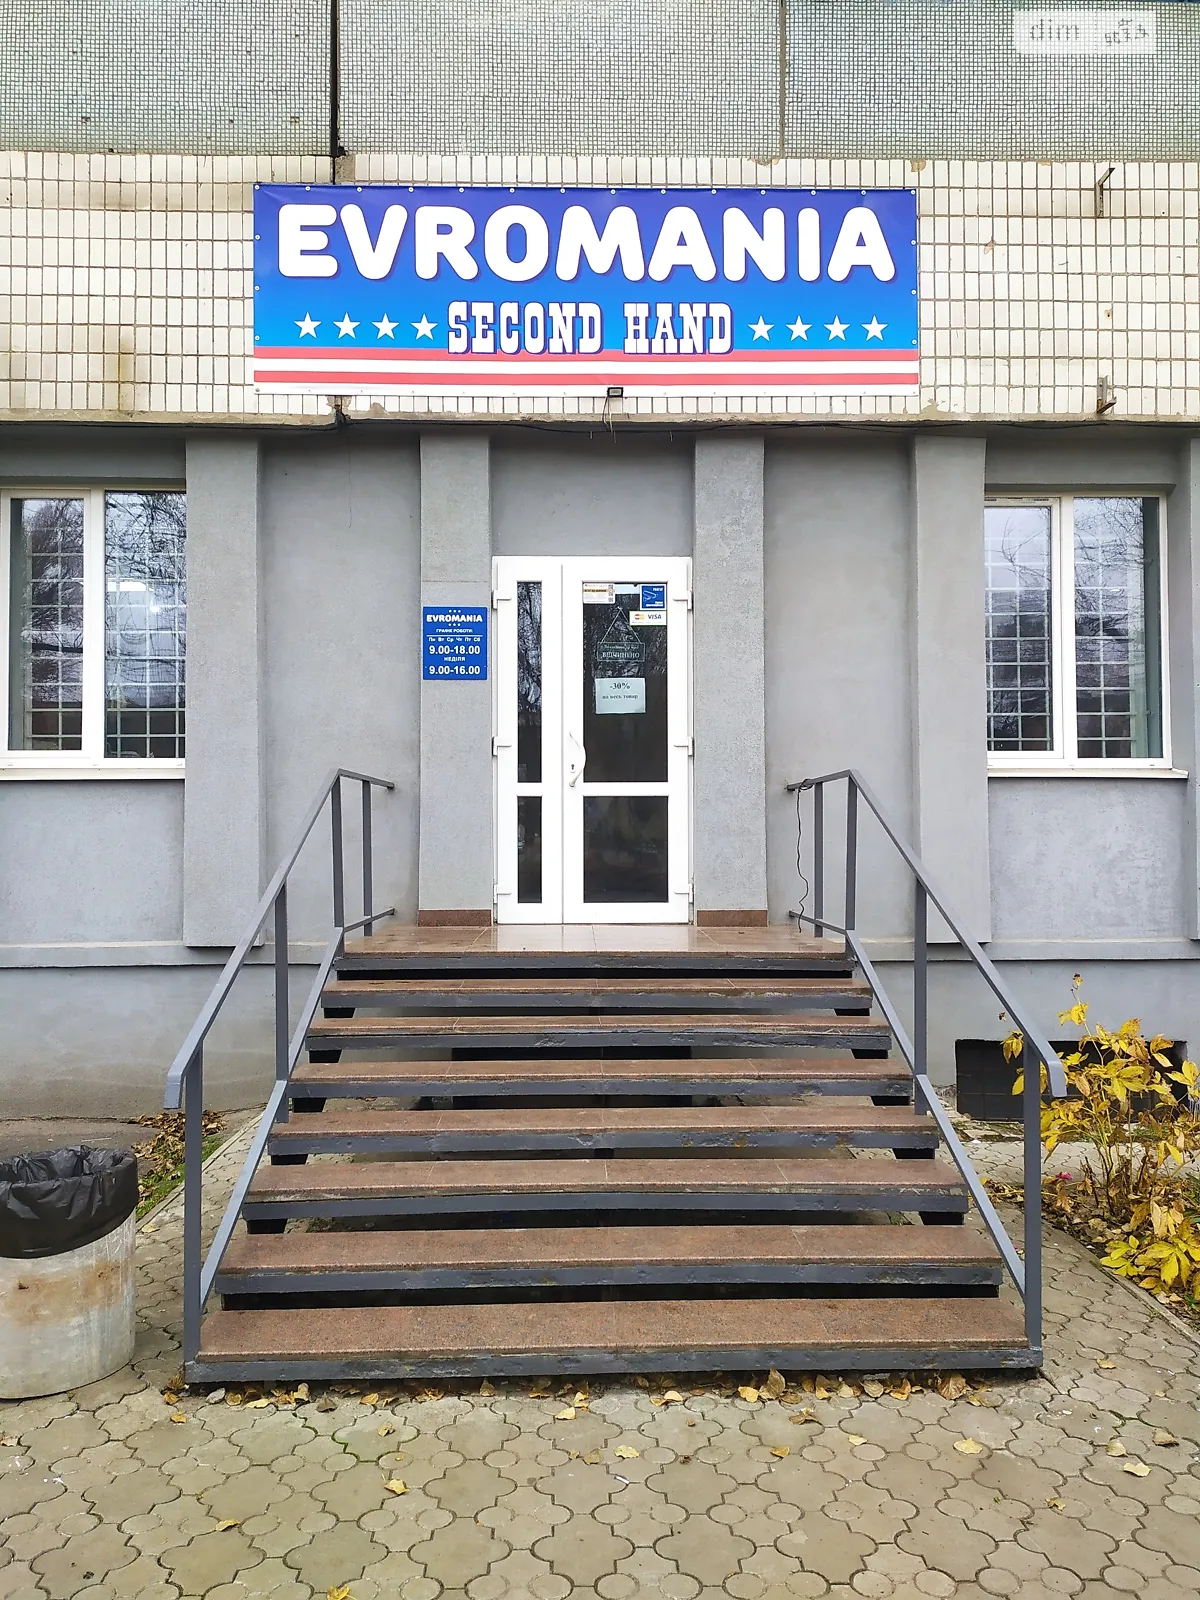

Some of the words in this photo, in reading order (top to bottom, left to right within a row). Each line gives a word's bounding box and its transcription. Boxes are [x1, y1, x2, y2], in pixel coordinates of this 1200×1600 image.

[276, 203, 897, 283] EVROMANIA
[446, 301, 604, 355] SECOND
[623, 301, 735, 356] HAND
[426, 614, 483, 623] EVROMANIA
[429, 645, 481, 655] 9.00-18.00
[429, 665, 481, 675] 9.00-16.00
[609, 682, 631, 690] -30%
